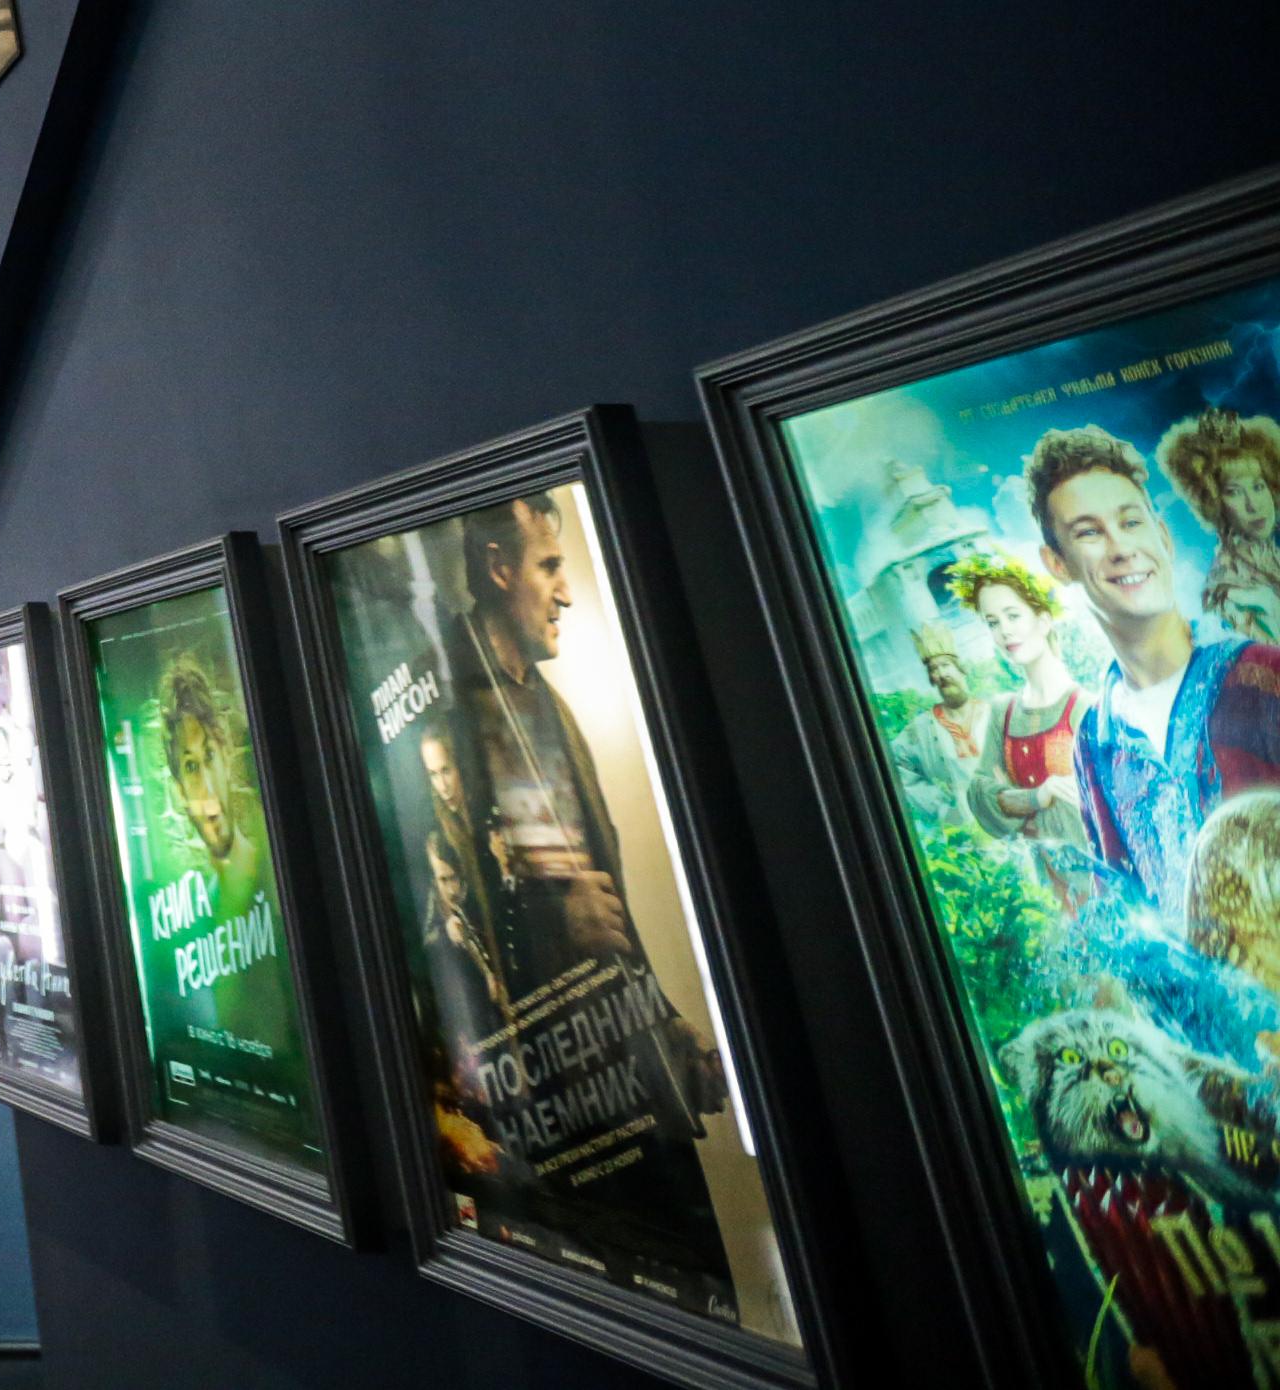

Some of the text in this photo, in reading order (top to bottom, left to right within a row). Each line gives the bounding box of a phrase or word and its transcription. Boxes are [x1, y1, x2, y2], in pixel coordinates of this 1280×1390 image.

[1061, 371, 1116, 398] ФИЛЬМА
[371, 662, 413, 716] ЛИАМ
[377, 670, 440, 744] НИСОН
[149, 869, 212, 941] КНИГА
[175, 890, 277, 997] РЕШЕНИЙ
[477, 963, 668, 1107] ПОСЛЕДНИЙ
[496, 1055, 647, 1153] НАЕМНИК
